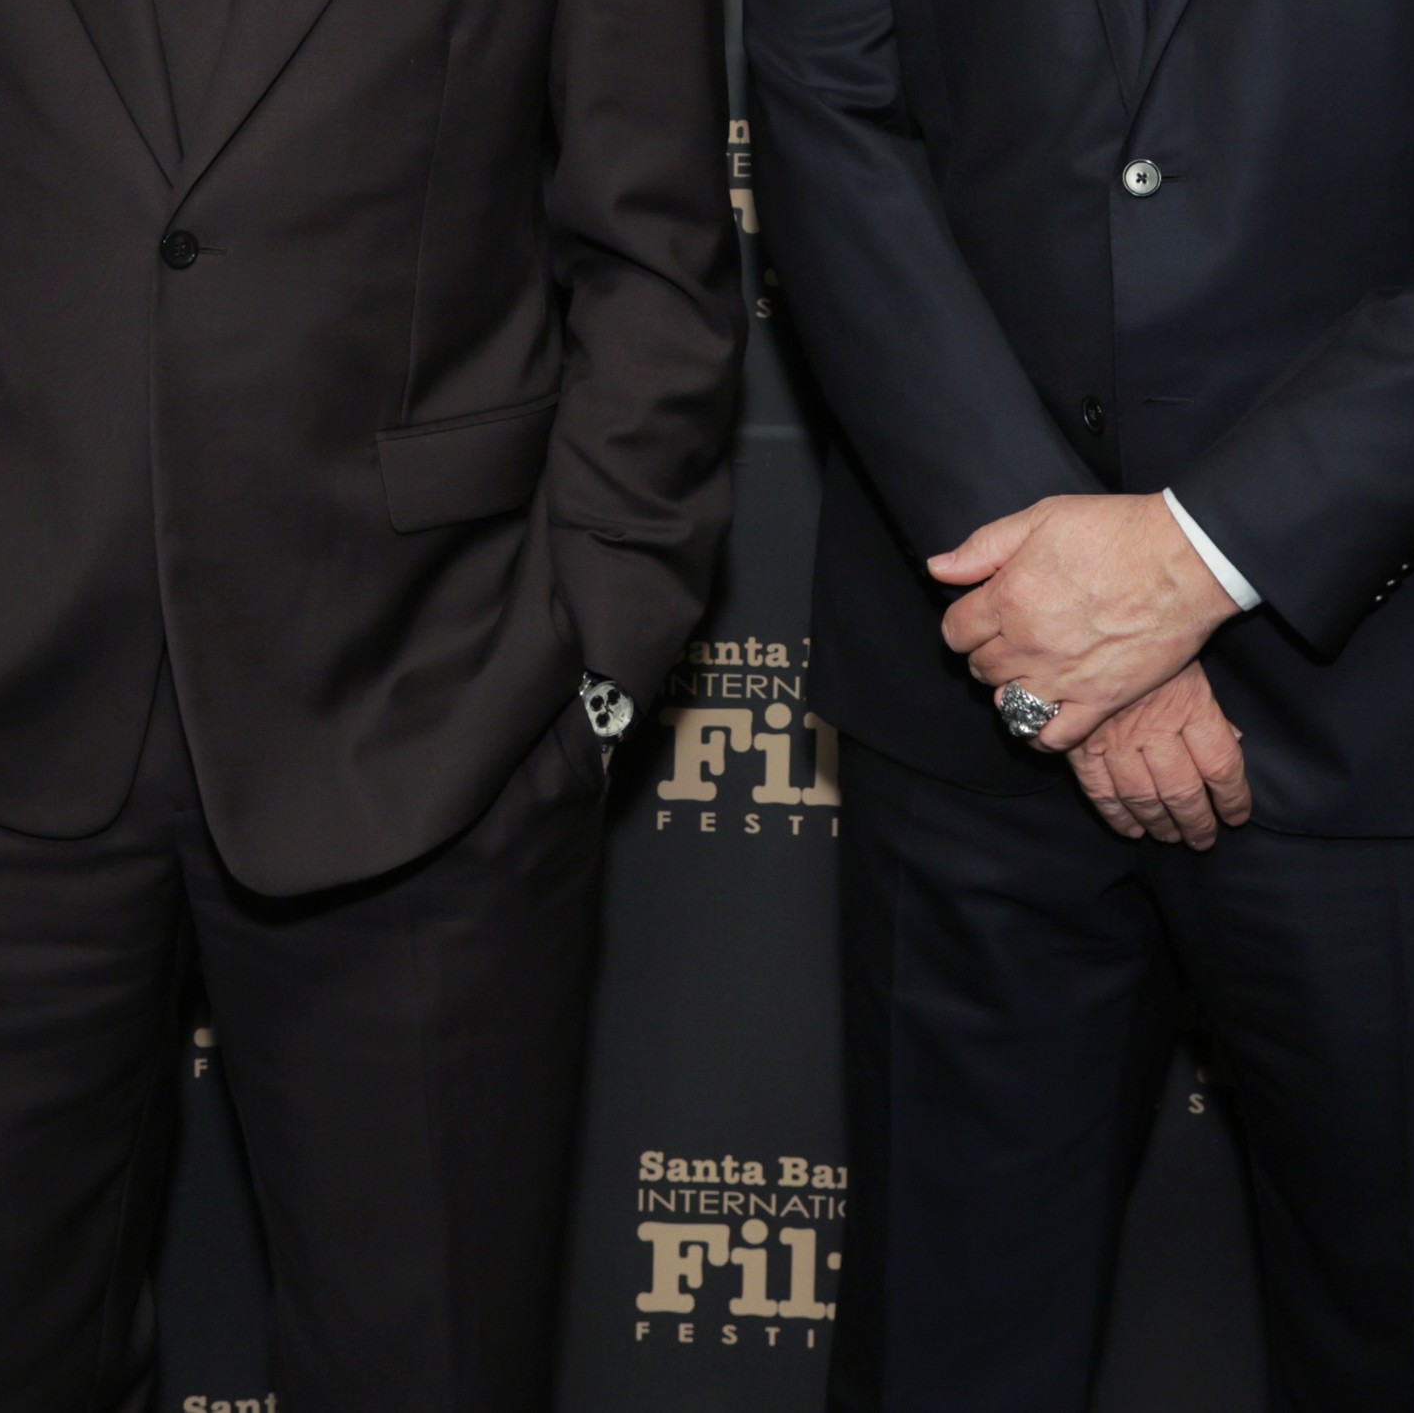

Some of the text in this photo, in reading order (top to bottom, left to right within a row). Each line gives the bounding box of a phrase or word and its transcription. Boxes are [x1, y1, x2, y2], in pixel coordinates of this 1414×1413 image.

[657, 702, 842, 807] Fil
[656, 810, 839, 837] FESTI
[640, 1151, 766, 1185] Santa
[638, 1188, 848, 1220] INTERNATI
[635, 1218, 843, 1322] Fil
[635, 1321, 816, 1349] FESTI
